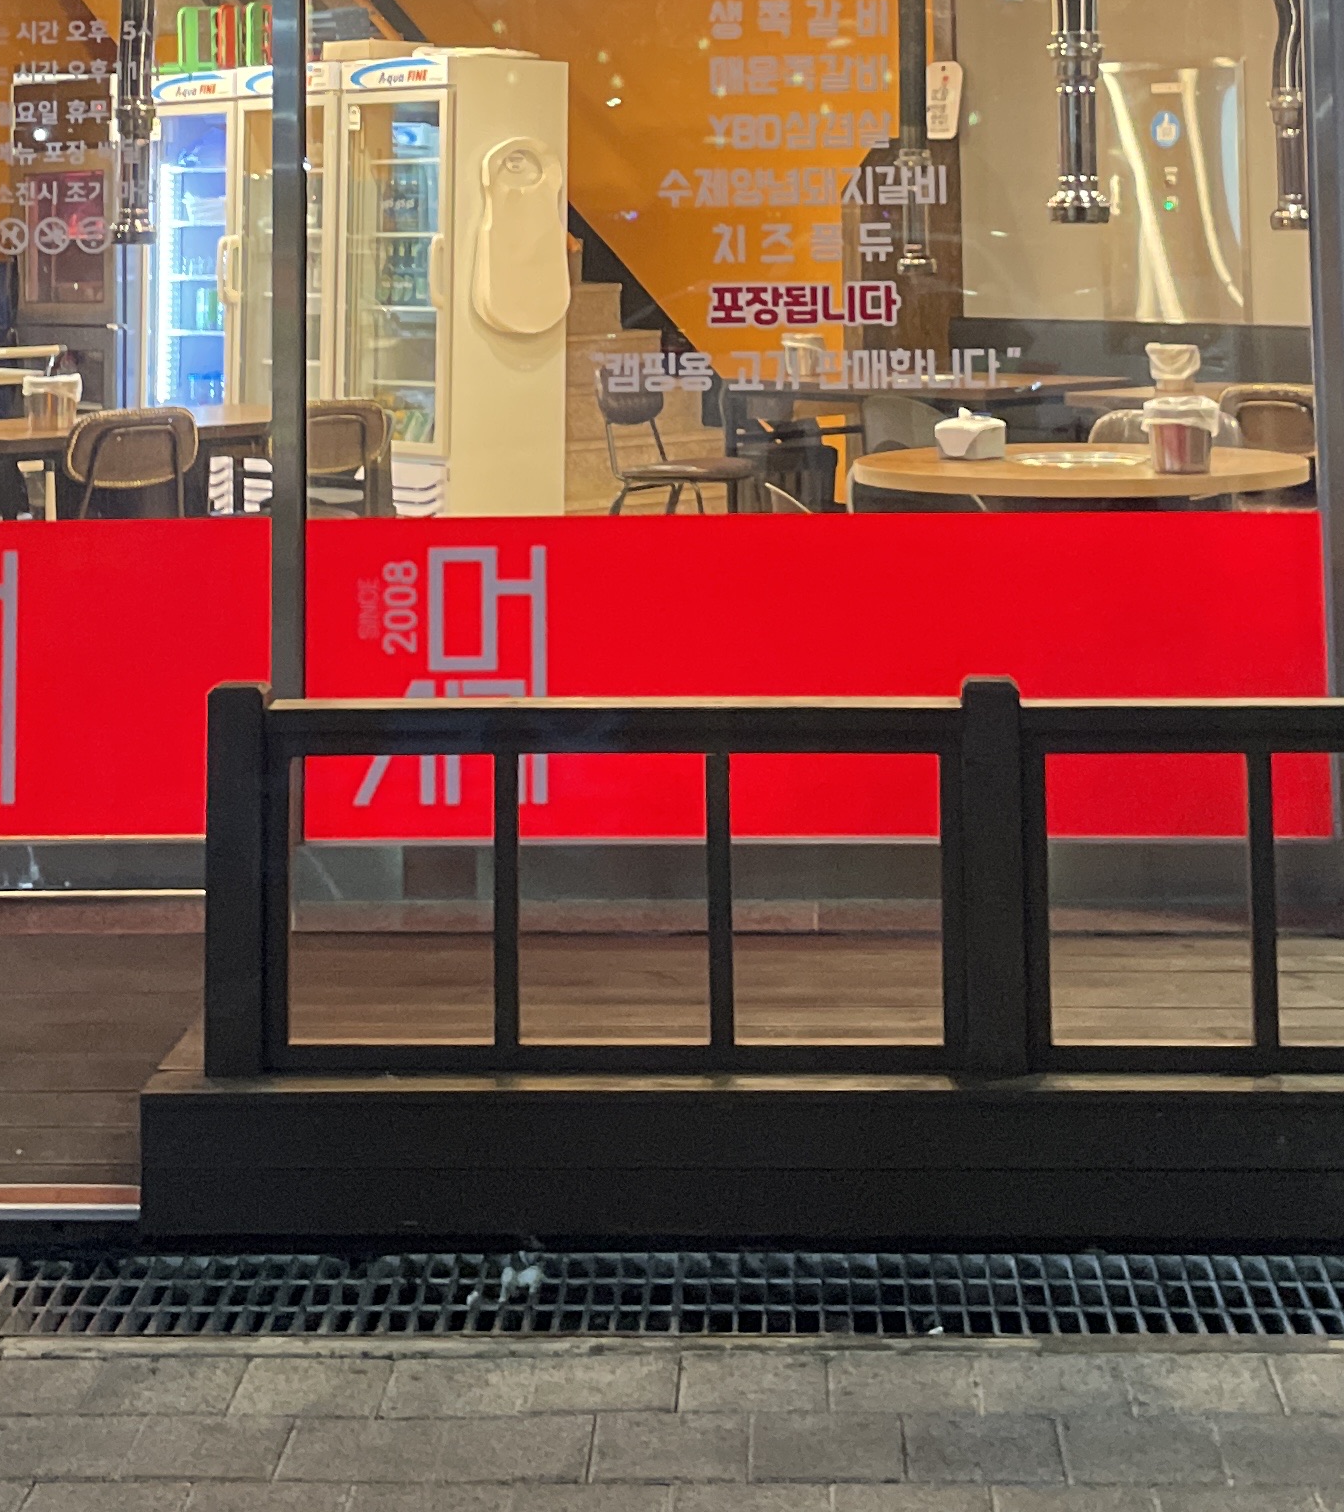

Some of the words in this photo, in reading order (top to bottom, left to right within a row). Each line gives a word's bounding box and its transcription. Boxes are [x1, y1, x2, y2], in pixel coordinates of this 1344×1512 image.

[16, 20, 59, 44] 시간
[66, 18, 109, 43] 오후
[16, 59, 58, 83] 시간
[378, 72, 405, 86] Aqua
[407, 69, 429, 82] FINE
[65, 99, 109, 124] 휴무
[43, 139, 87, 165] 포장
[707, 280, 902, 329] 포장됩니다
[728, 350, 798, 392] 고기
[358, 578, 380, 640] SINCE
[382, 560, 418, 655] 2008
